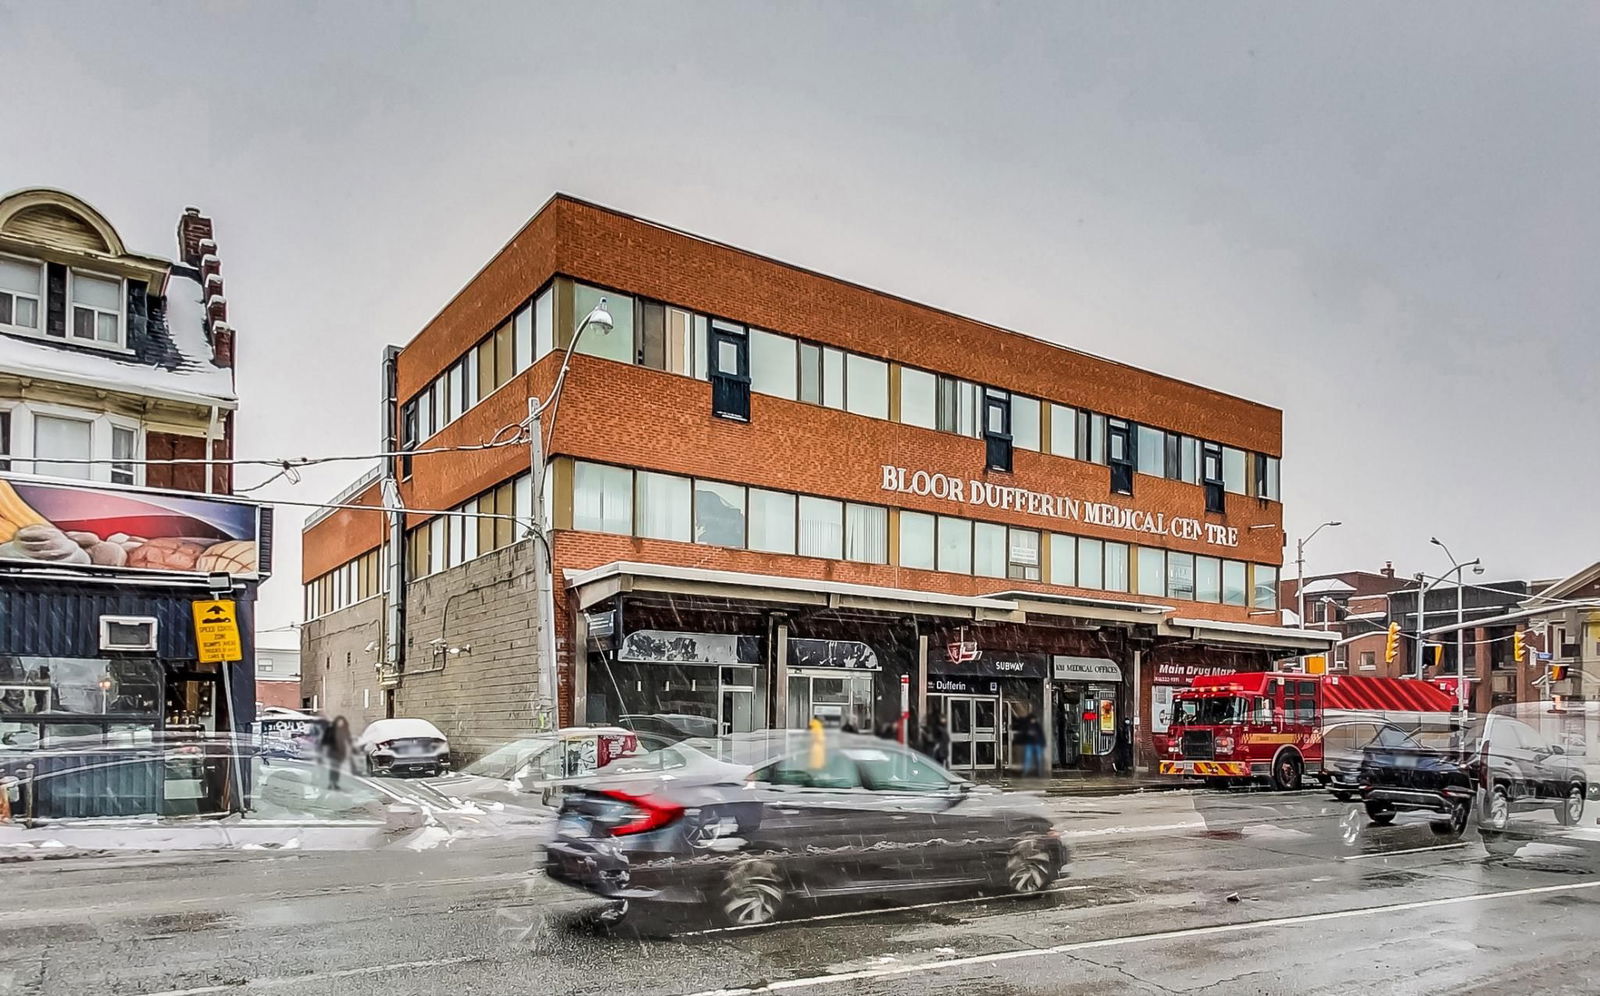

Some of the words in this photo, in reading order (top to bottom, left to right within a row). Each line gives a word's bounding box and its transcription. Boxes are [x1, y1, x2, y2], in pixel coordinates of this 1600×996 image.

[881, 465, 965, 503] BLOOR
[969, 480, 1080, 521] DUFFERIN
[1084, 501, 1169, 535] MEDICAL
[995, 661, 1025, 671] SUBWAY
[1066, 664, 1093, 673] MEDICAL
[1094, 666, 1118, 674] OFFICES
[1160, 664, 1185, 675] Main
[1186, 665, 1211, 677] Drug
[1211, 667, 1237, 677] Mart
[936, 680, 966, 691] Dufferin
